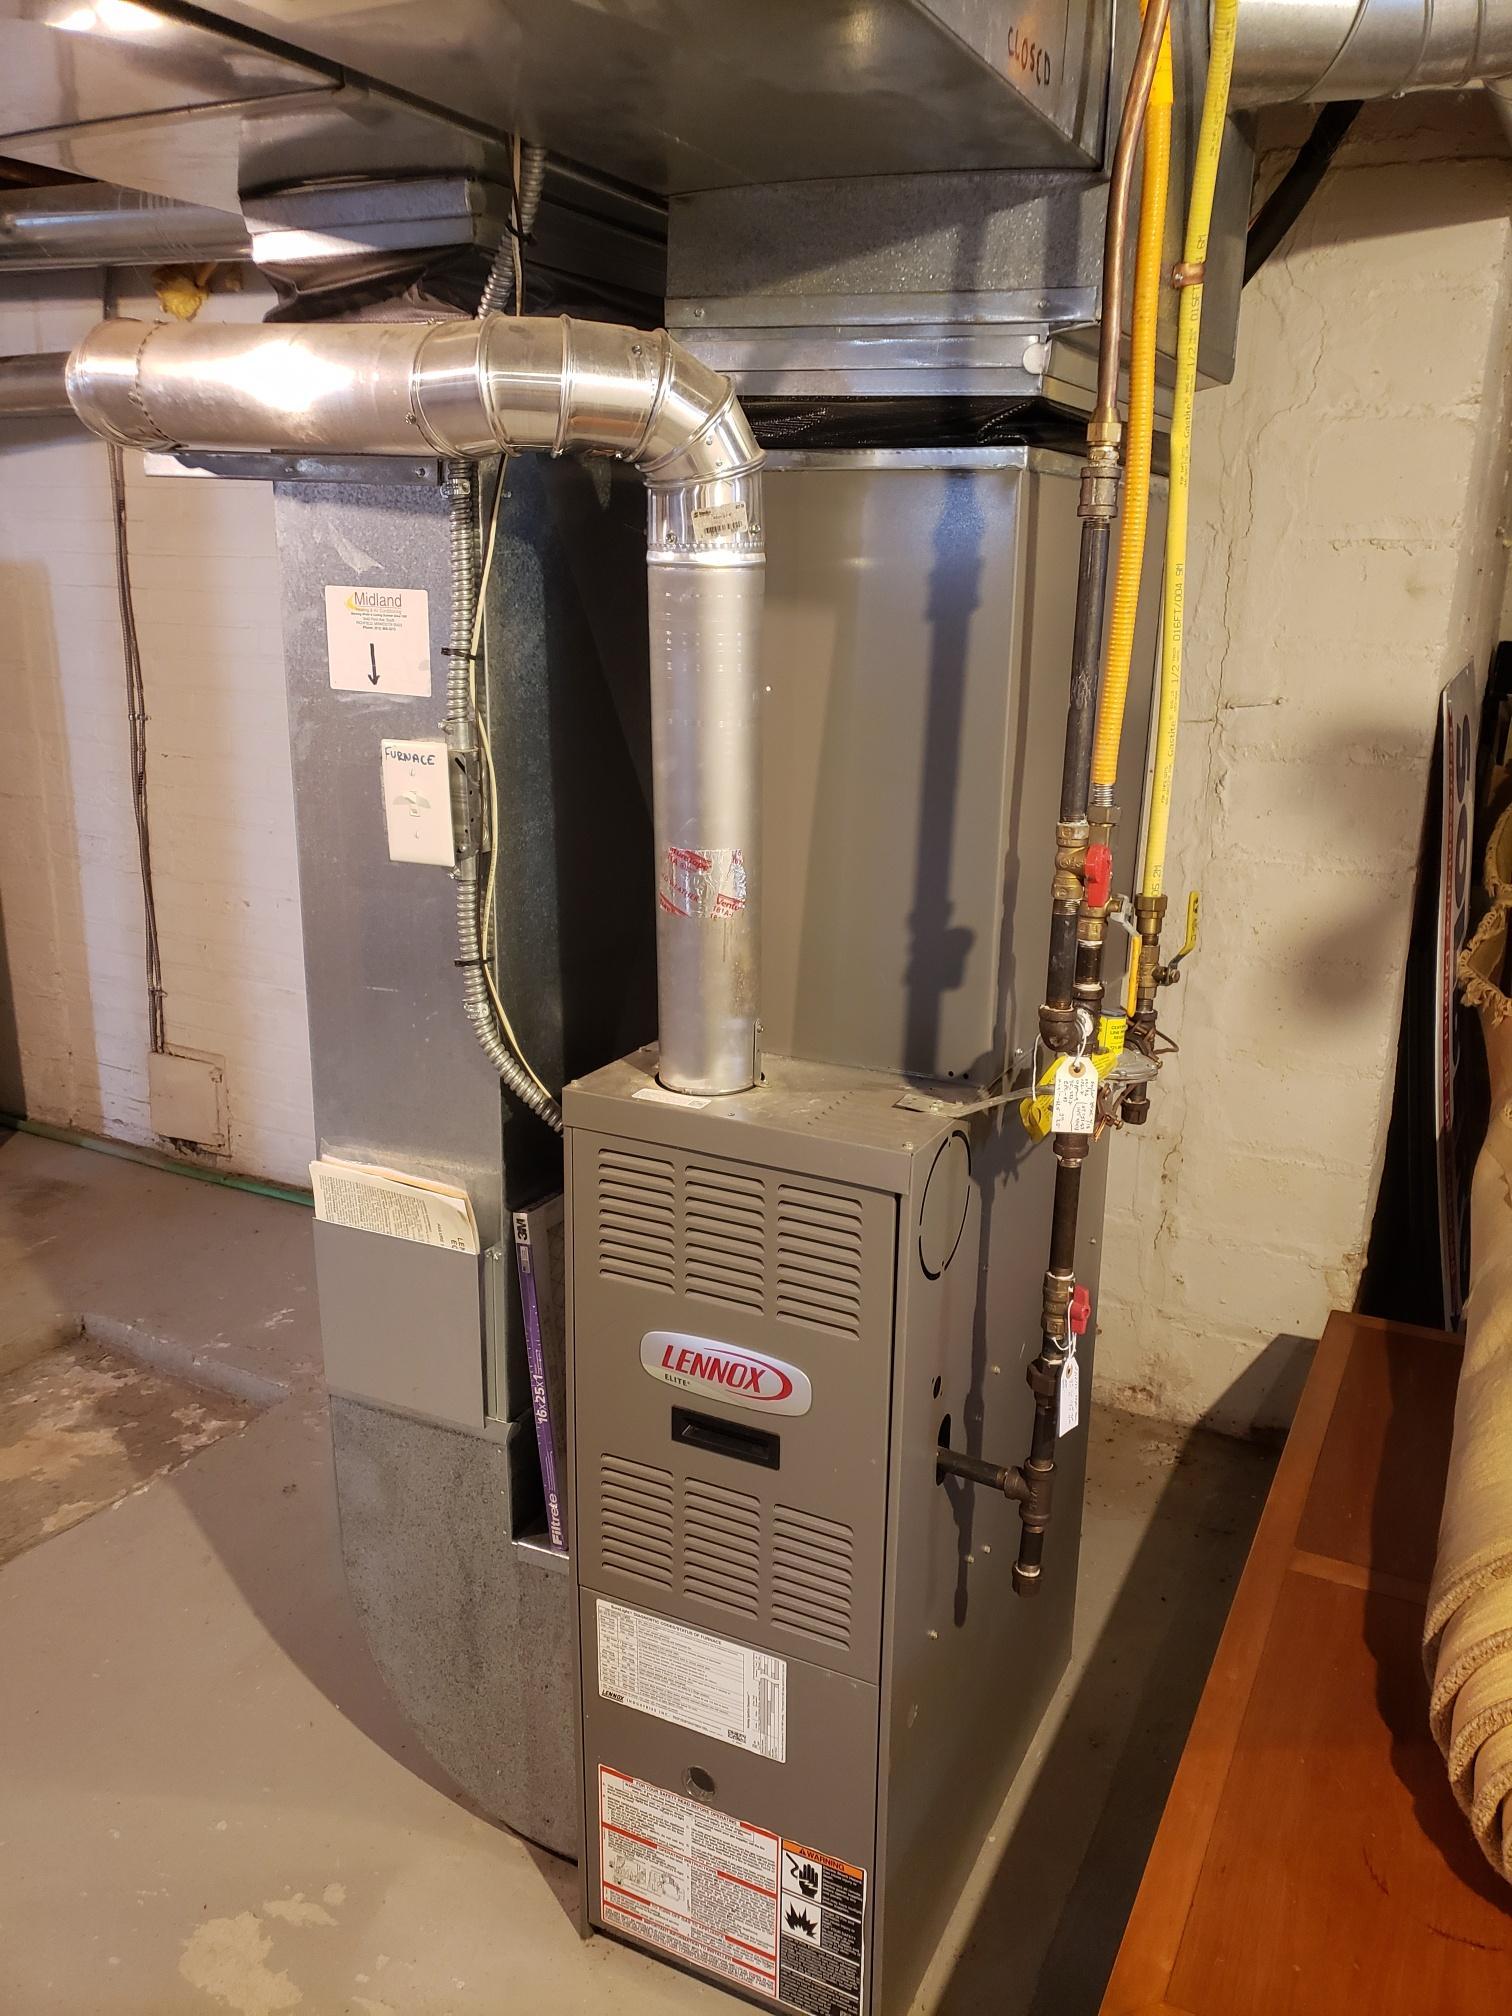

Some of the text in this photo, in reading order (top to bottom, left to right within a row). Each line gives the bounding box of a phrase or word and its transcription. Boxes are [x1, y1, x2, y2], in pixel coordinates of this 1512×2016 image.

[354, 591, 402, 607] Midland
[1171, 665, 1180, 684] 1/2
[385, 746, 436, 765] FURNACE
[516, 1218, 528, 1241] 3M
[661, 1344, 766, 1394] LENNOX
[533, 1374, 548, 1424] 16x25x1
[549, 1493, 563, 1545] Filtrete
[602, 1690, 625, 1703] LENNOX
[805, 1851, 846, 1872] WARNING
